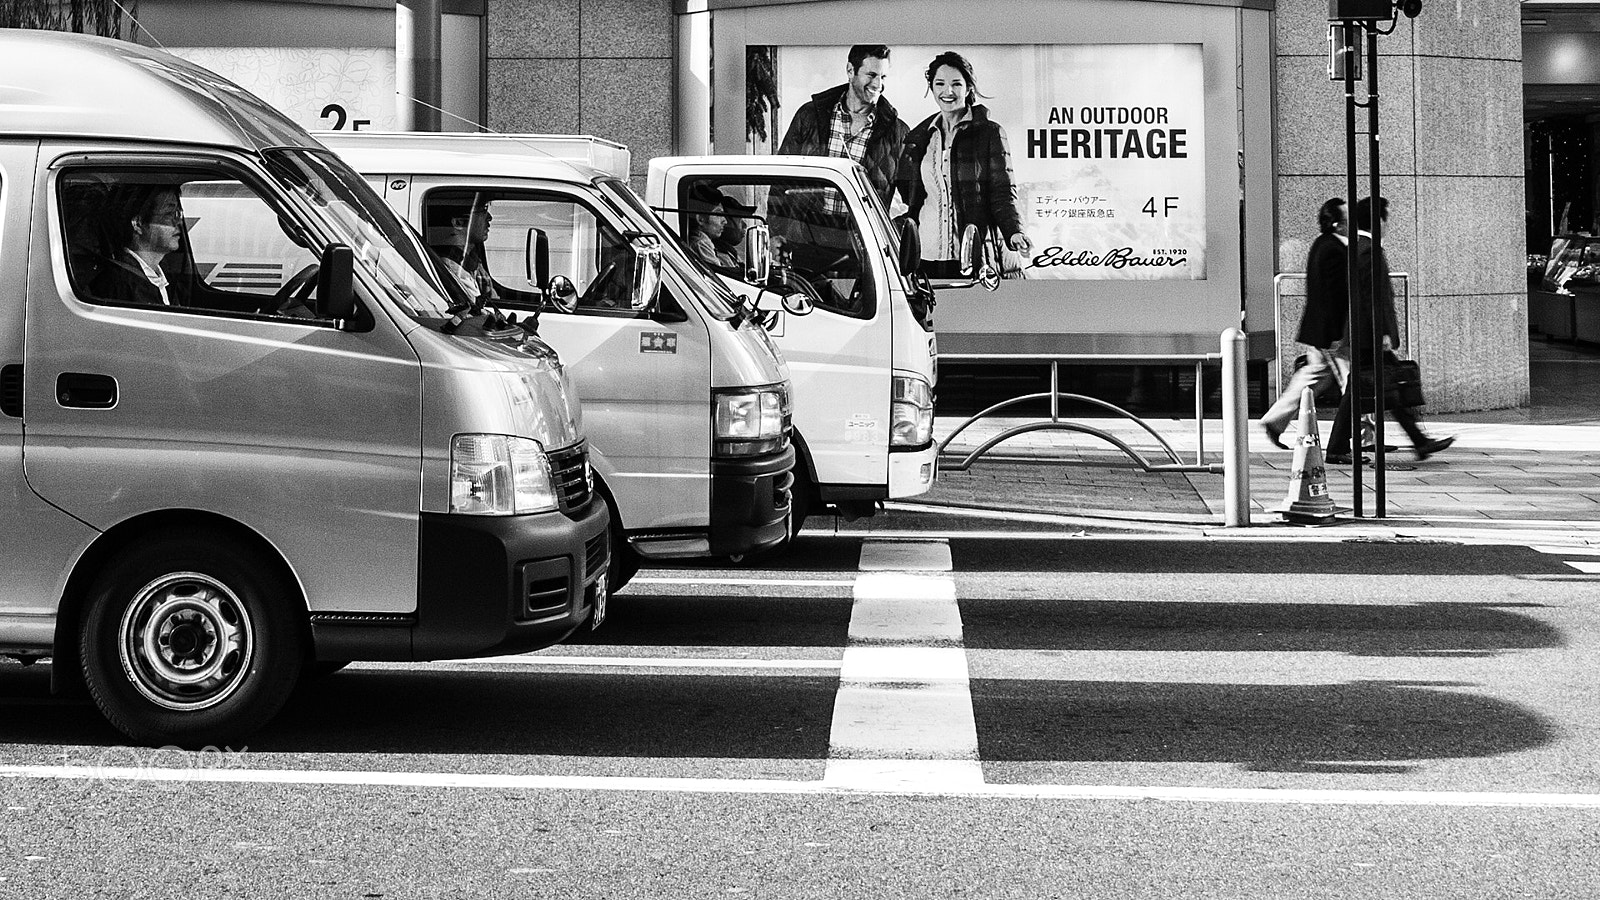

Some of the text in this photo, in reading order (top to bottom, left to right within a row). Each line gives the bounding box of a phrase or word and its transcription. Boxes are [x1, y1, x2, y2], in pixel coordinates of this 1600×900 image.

[1048, 107, 1168, 124] AN OUTDOOR
[1027, 129, 1187, 158] HERITAGE
[1036, 196, 1107, 205] エディー・バウアー
[1035, 208, 1115, 219] モザイク銀座阪急店
[1025, 246, 1187, 270] Eddie Bauer
